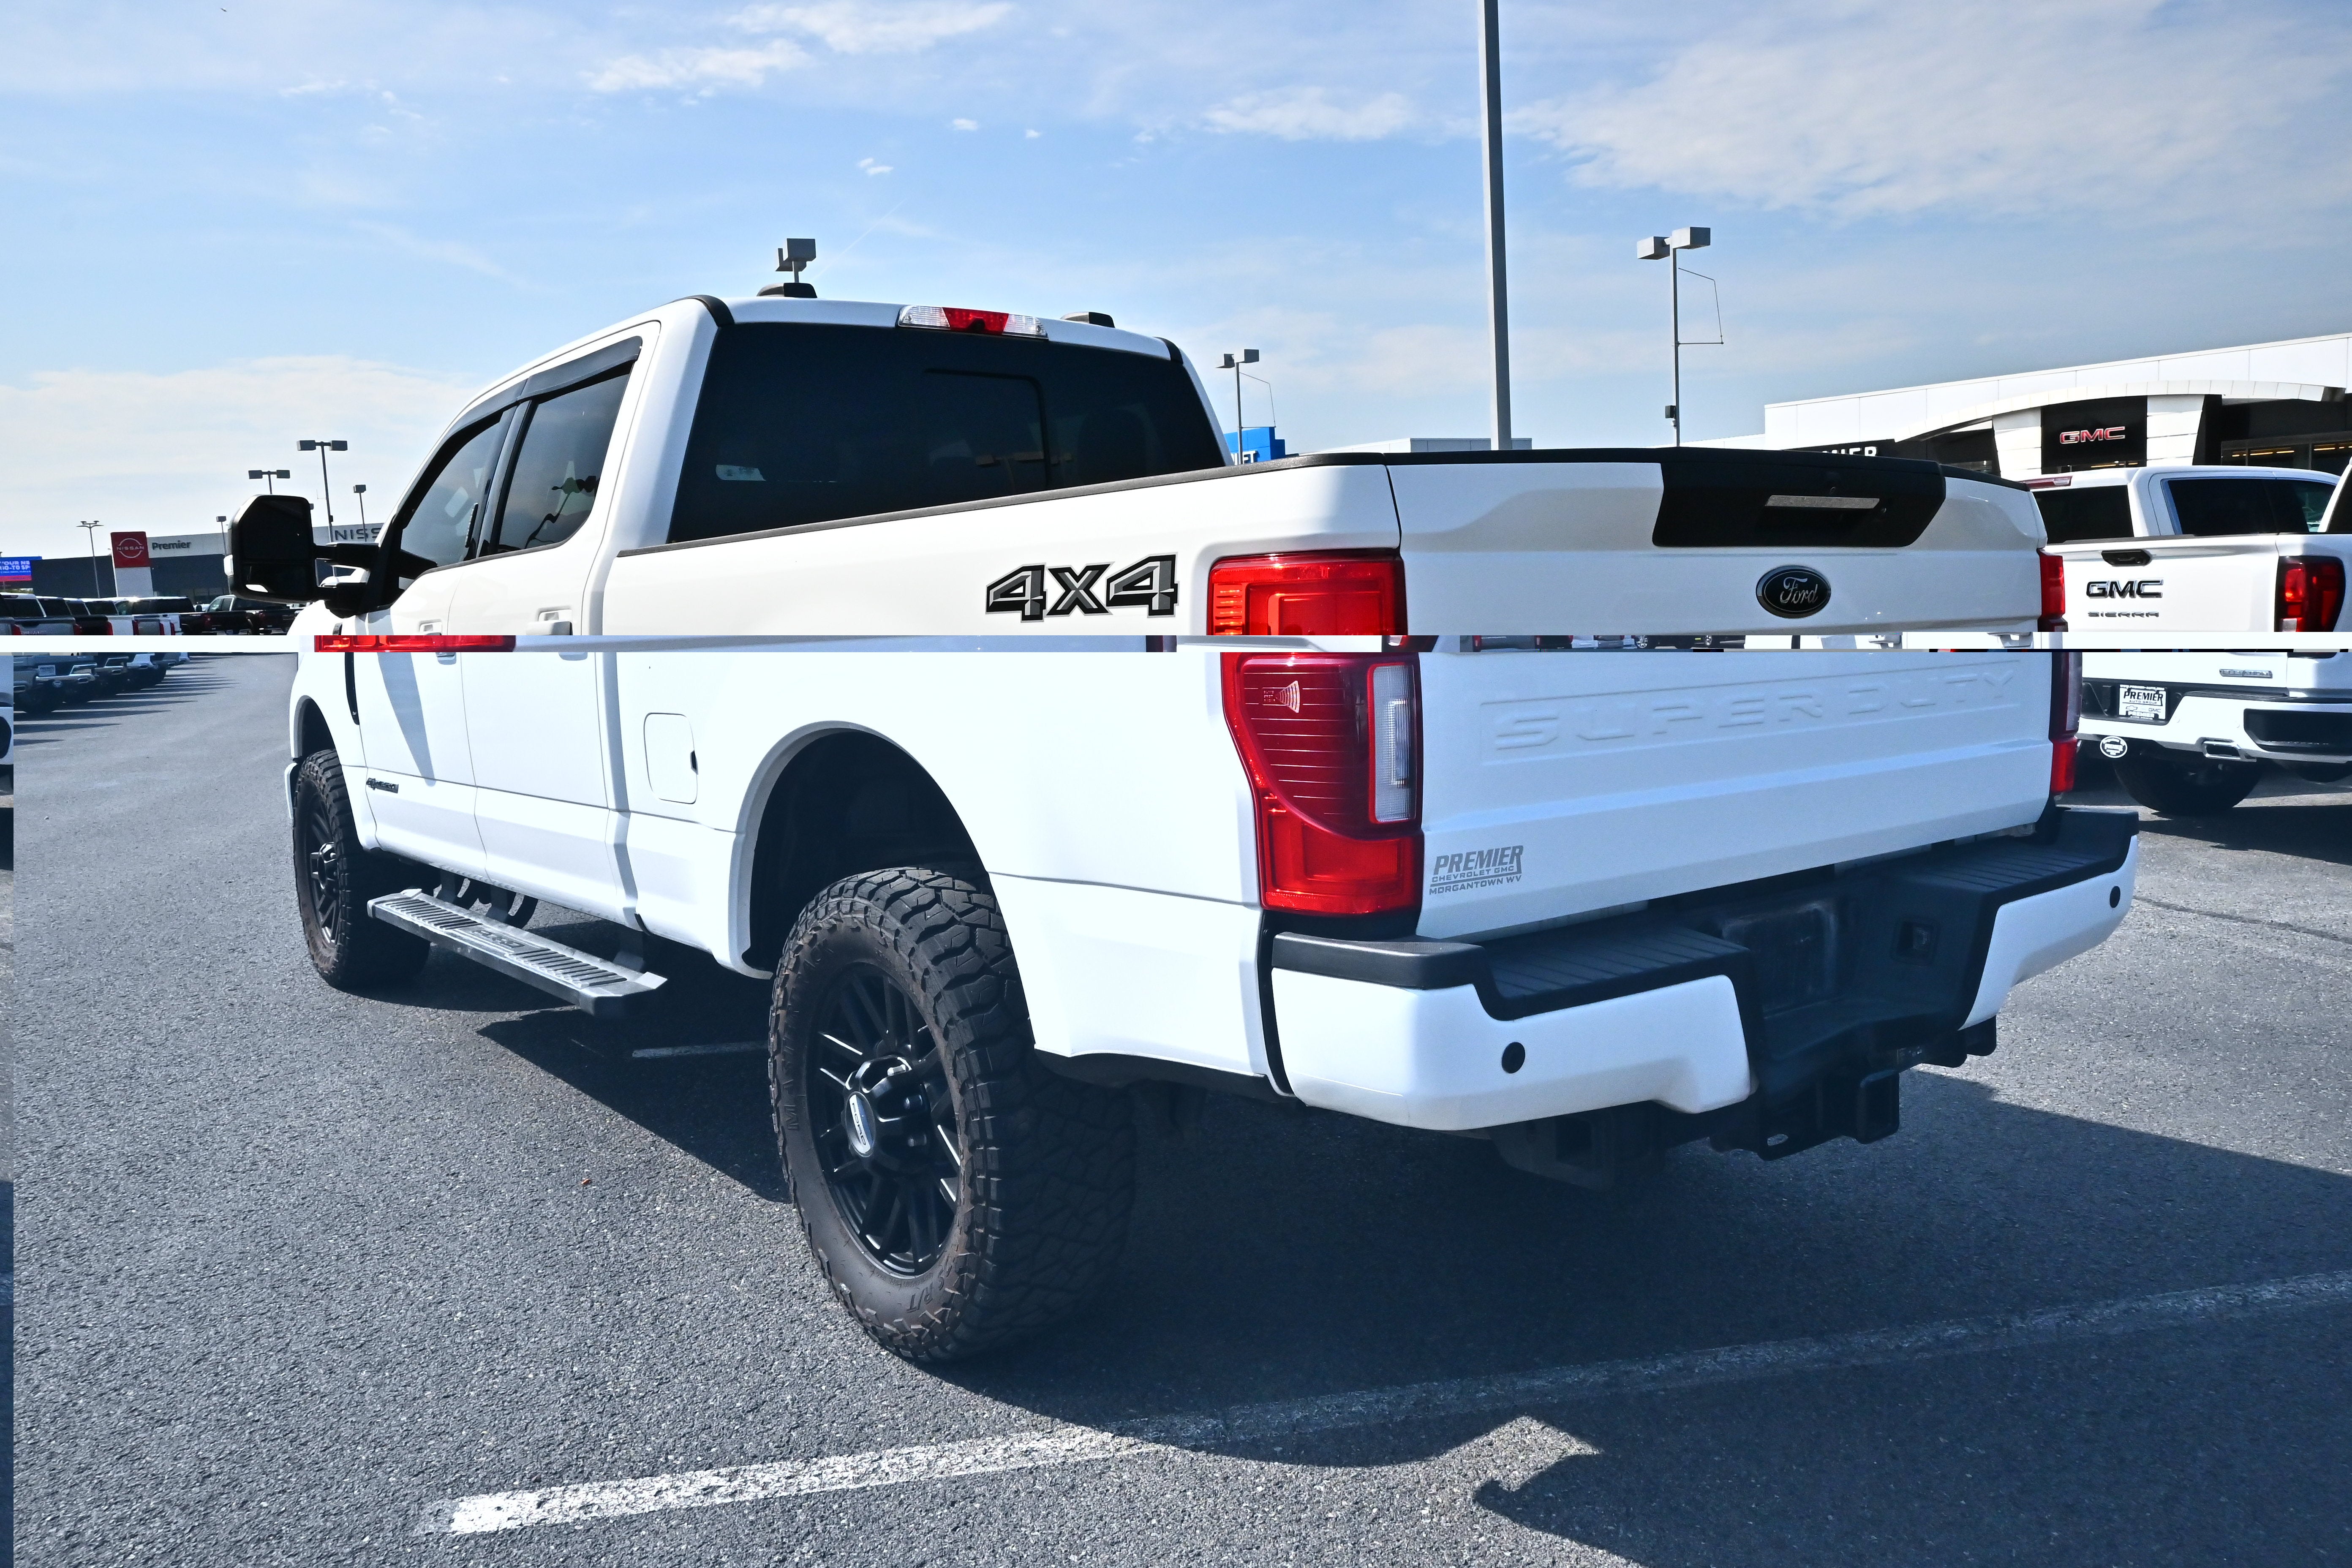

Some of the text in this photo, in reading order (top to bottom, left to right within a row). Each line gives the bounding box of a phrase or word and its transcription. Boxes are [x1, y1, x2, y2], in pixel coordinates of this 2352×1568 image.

[2060, 426, 2125, 444] GMC
[152, 540, 191, 550] Premier
[1780, 577, 1818, 604] Ford
[2086, 579, 2164, 599] GMC
[2123, 691, 2163, 702] PREMIER
[1493, 670, 2015, 751] SUPER DUTY
[1434, 845, 1524, 875] PREMIER
[1432, 866, 1514, 882] CHEVROLET GMC
[1429, 875, 1522, 895] MORGANTOWN WV
[852, 1102, 866, 1146] FORD
